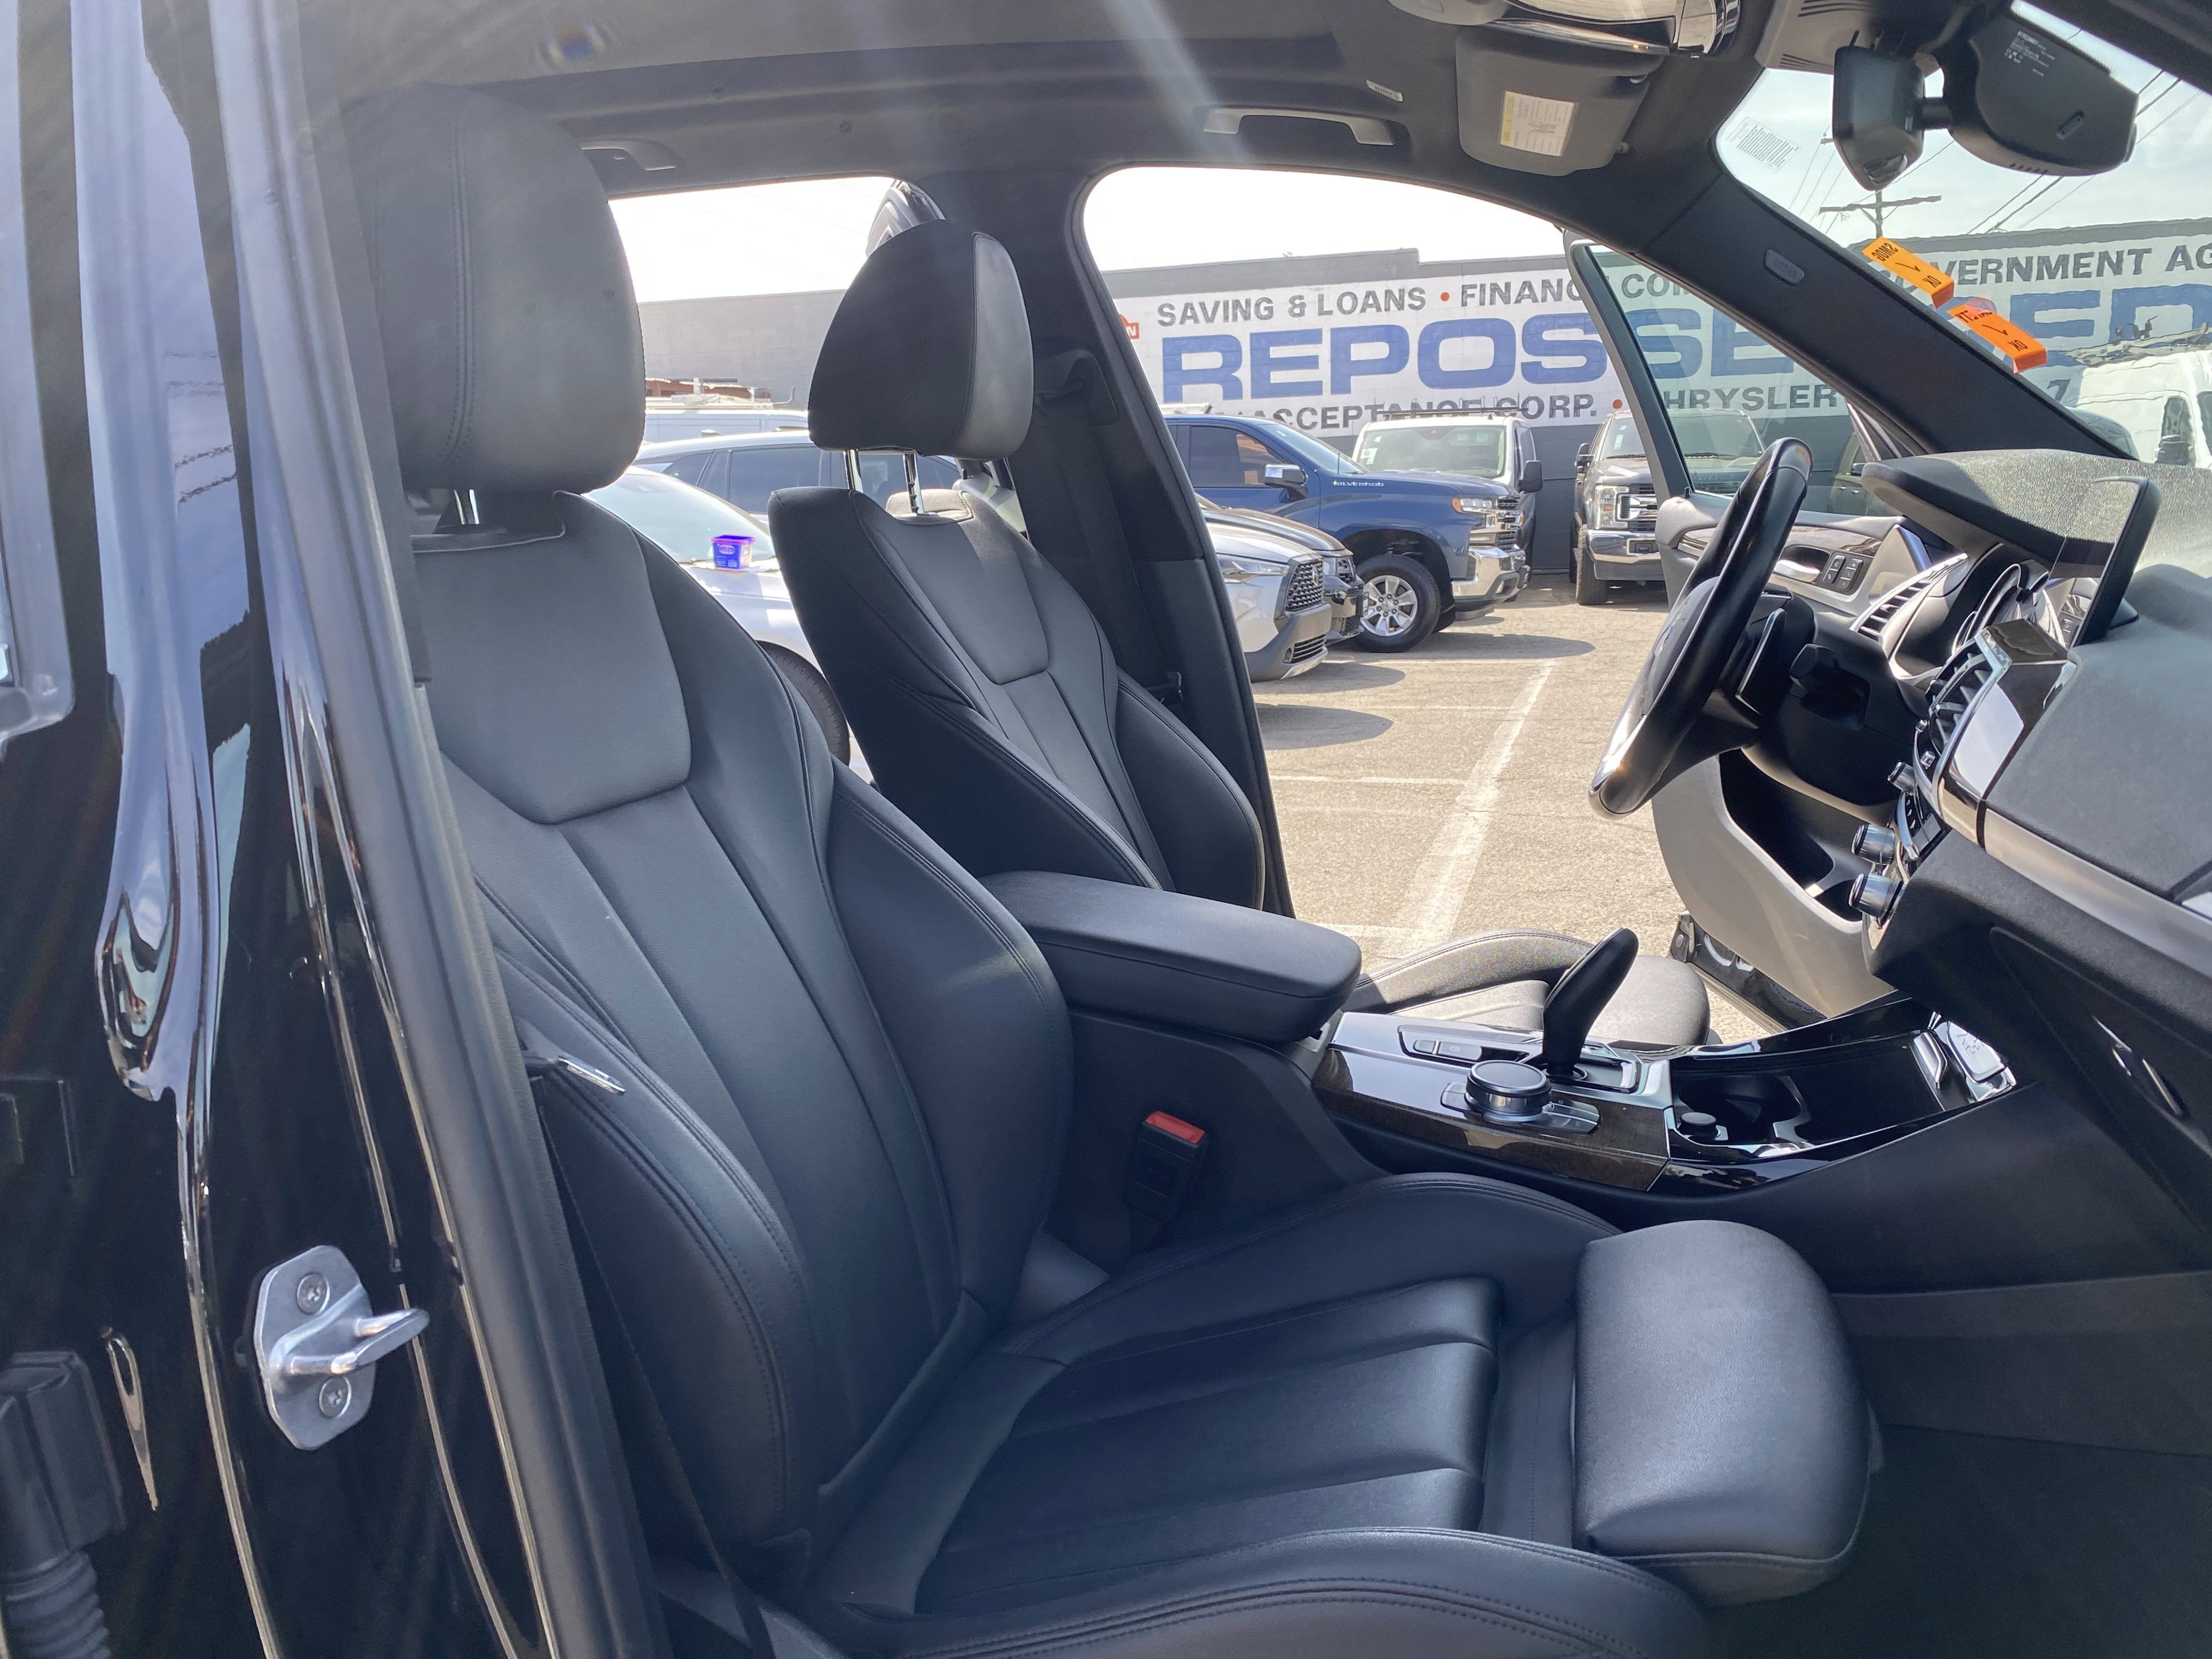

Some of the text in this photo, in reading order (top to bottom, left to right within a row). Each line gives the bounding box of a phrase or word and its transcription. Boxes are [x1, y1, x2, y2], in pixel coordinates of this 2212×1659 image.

[1158, 297, 1274, 328] SAVING
[1289, 295, 1306, 318] &
[1318, 287, 1426, 316] LOANS
[1462, 275, 1610, 307] FINANC
[1496, 394, 1597, 419] CORP.
[1663, 385, 1838, 411] HRYSLER
